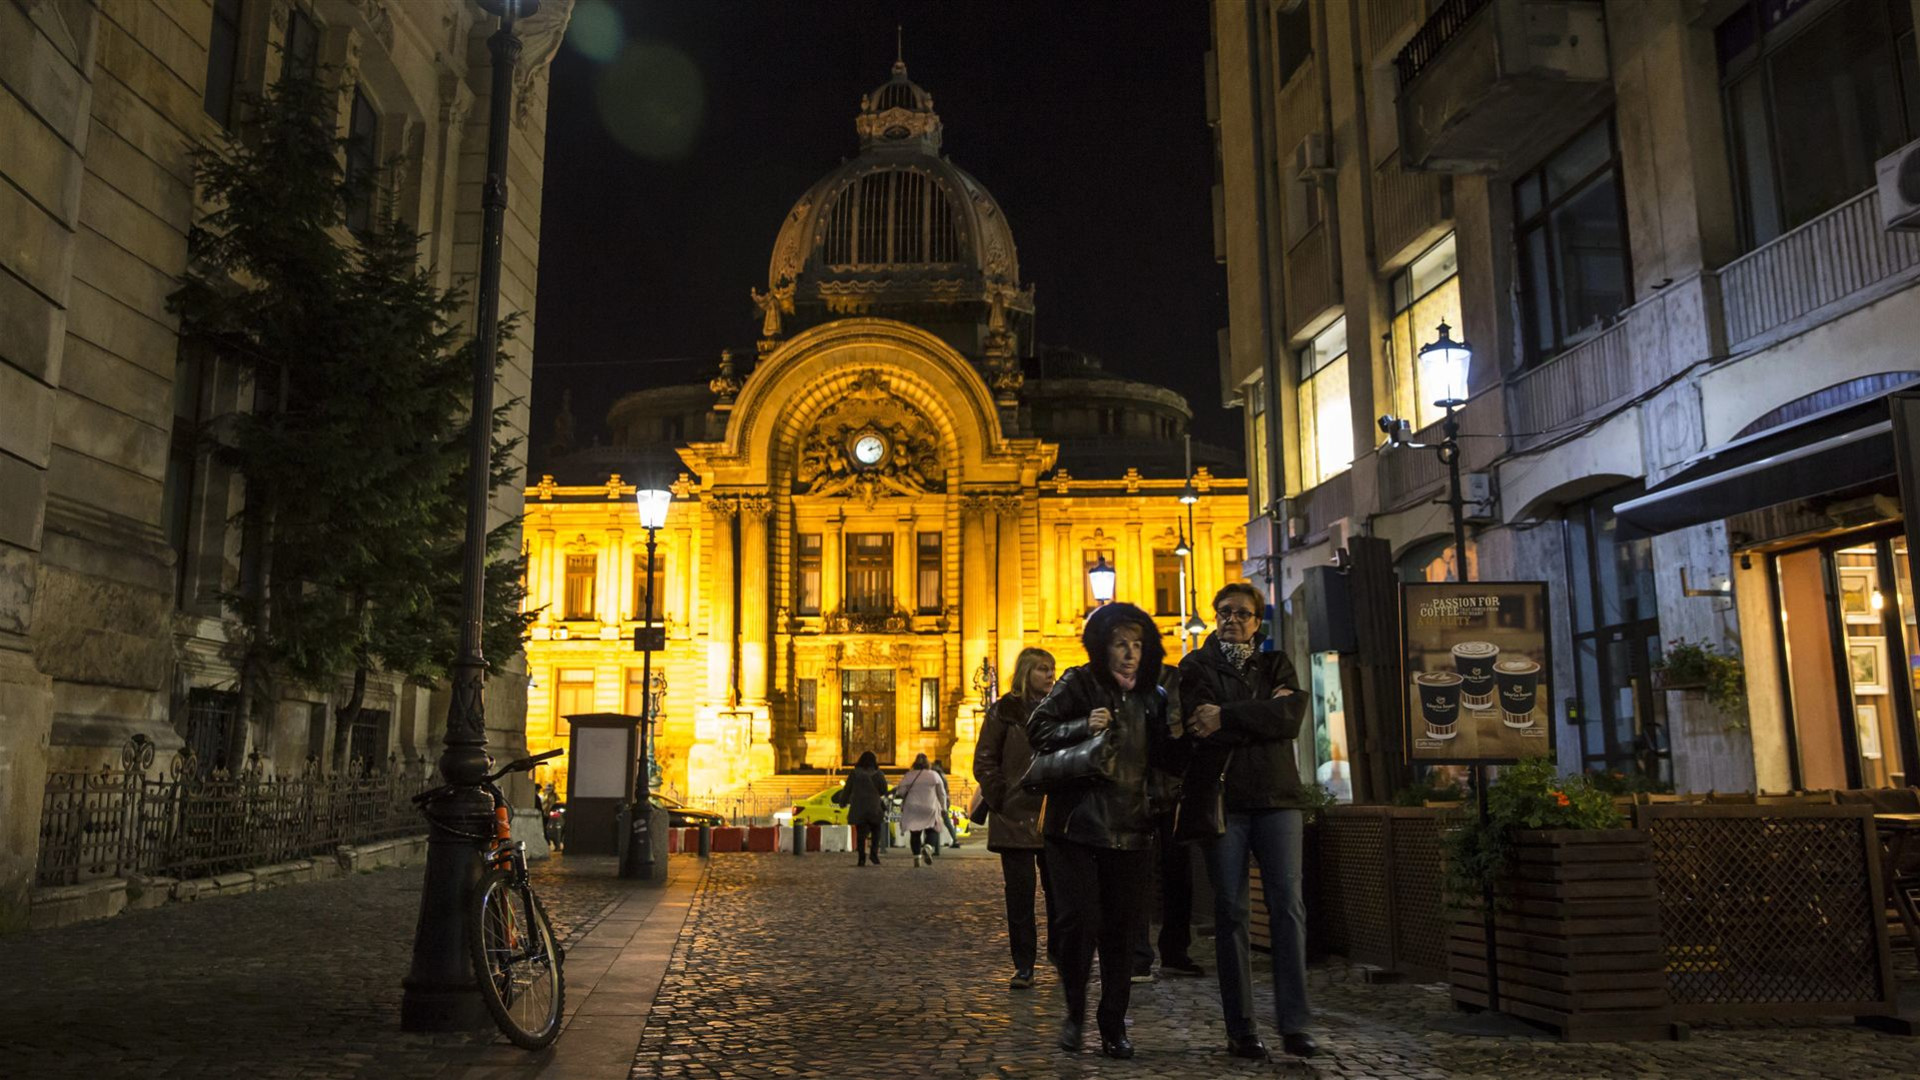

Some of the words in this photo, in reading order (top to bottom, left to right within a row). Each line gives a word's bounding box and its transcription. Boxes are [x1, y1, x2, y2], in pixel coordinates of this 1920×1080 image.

[1433, 597, 1476, 608] PASSION
[1478, 596, 1500, 607] FOR
[1420, 607, 1459, 617] COFFEE
